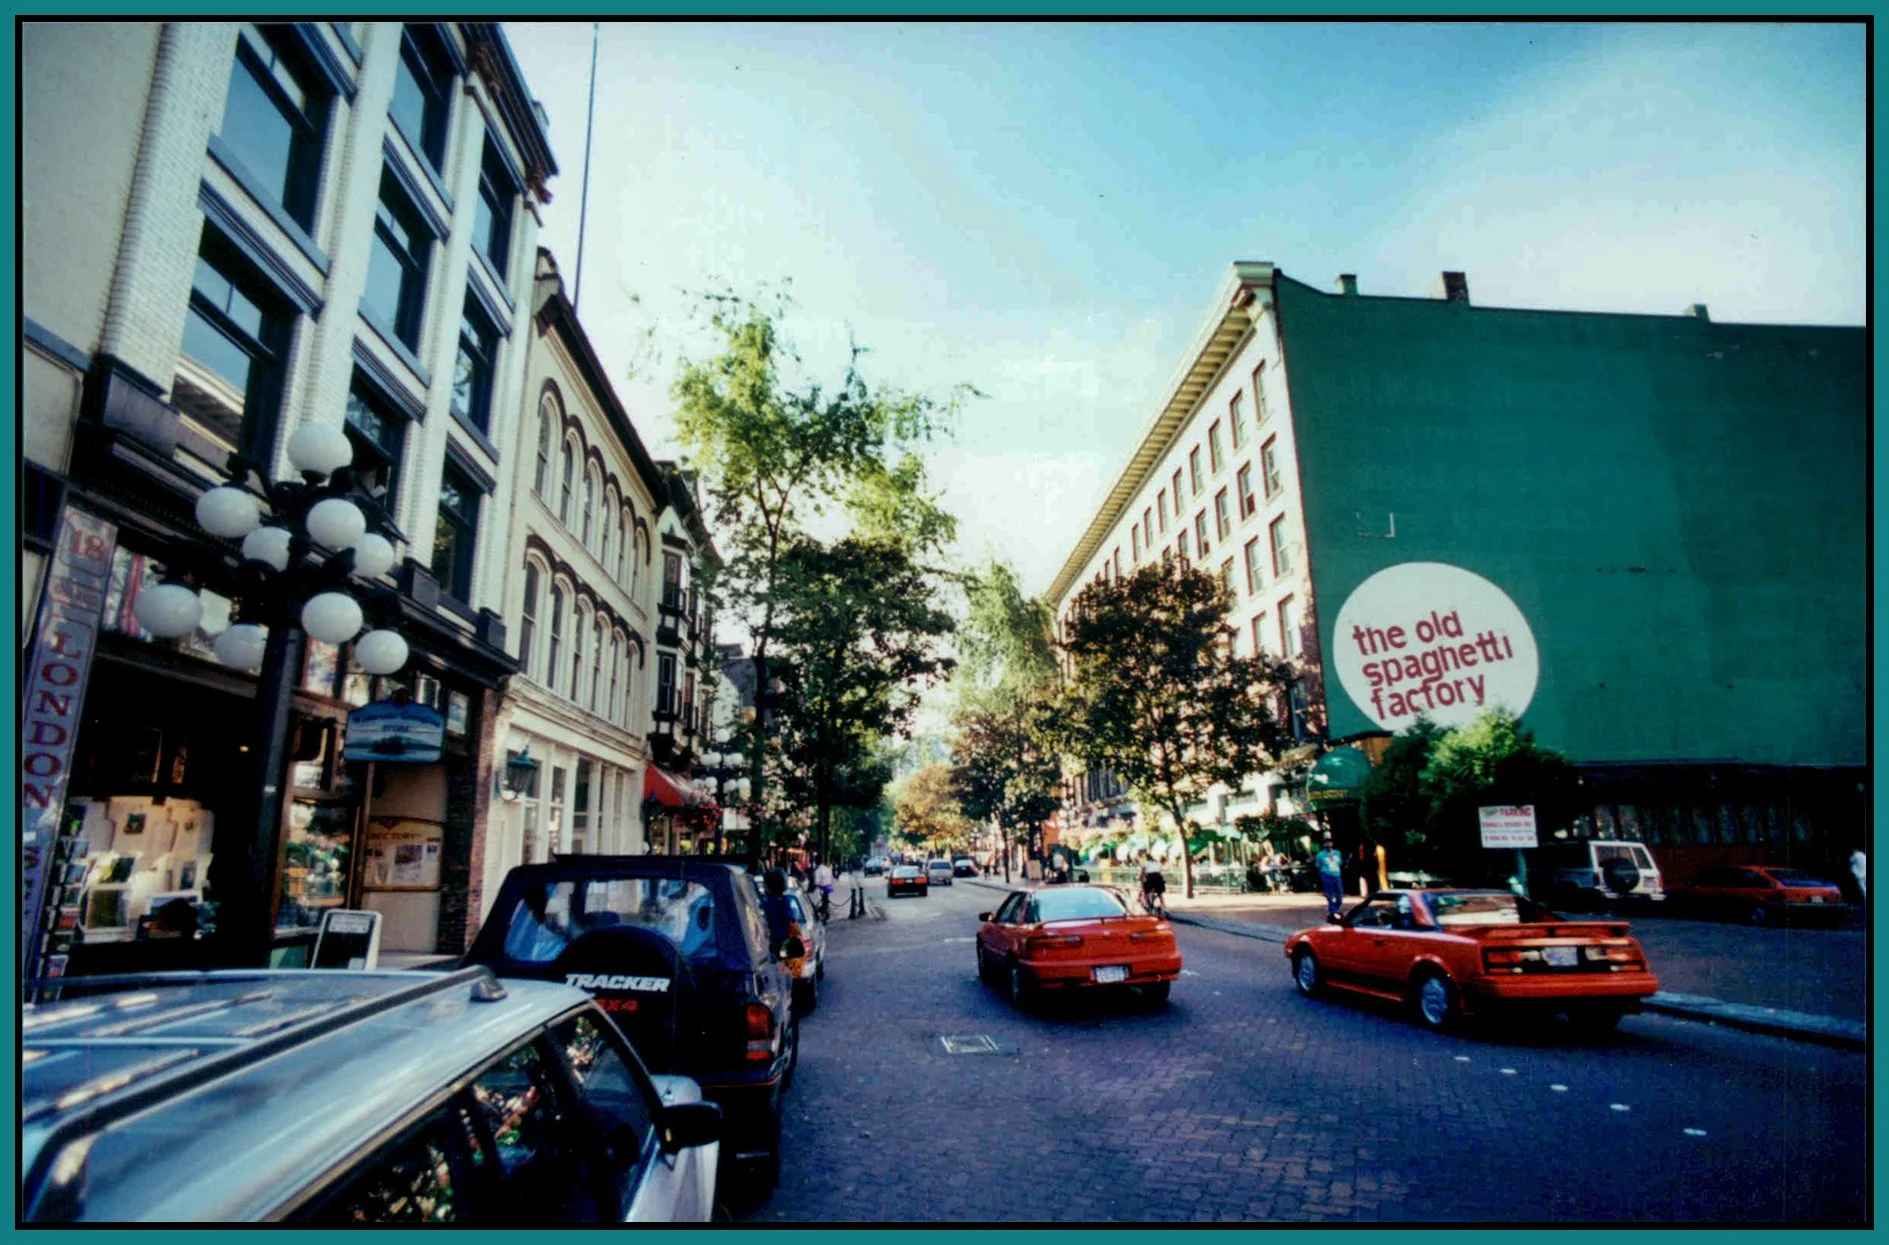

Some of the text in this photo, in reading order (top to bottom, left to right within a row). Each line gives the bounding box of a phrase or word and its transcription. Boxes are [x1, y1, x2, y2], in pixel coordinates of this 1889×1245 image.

[72, 529, 104, 561] 18
[1352, 611, 1464, 656] the old
[1362, 630, 1513, 687] spaghetti
[1370, 674, 1484, 720] factory
[23, 632, 81, 809] LONDON
[565, 973, 670, 992] TRACKER
